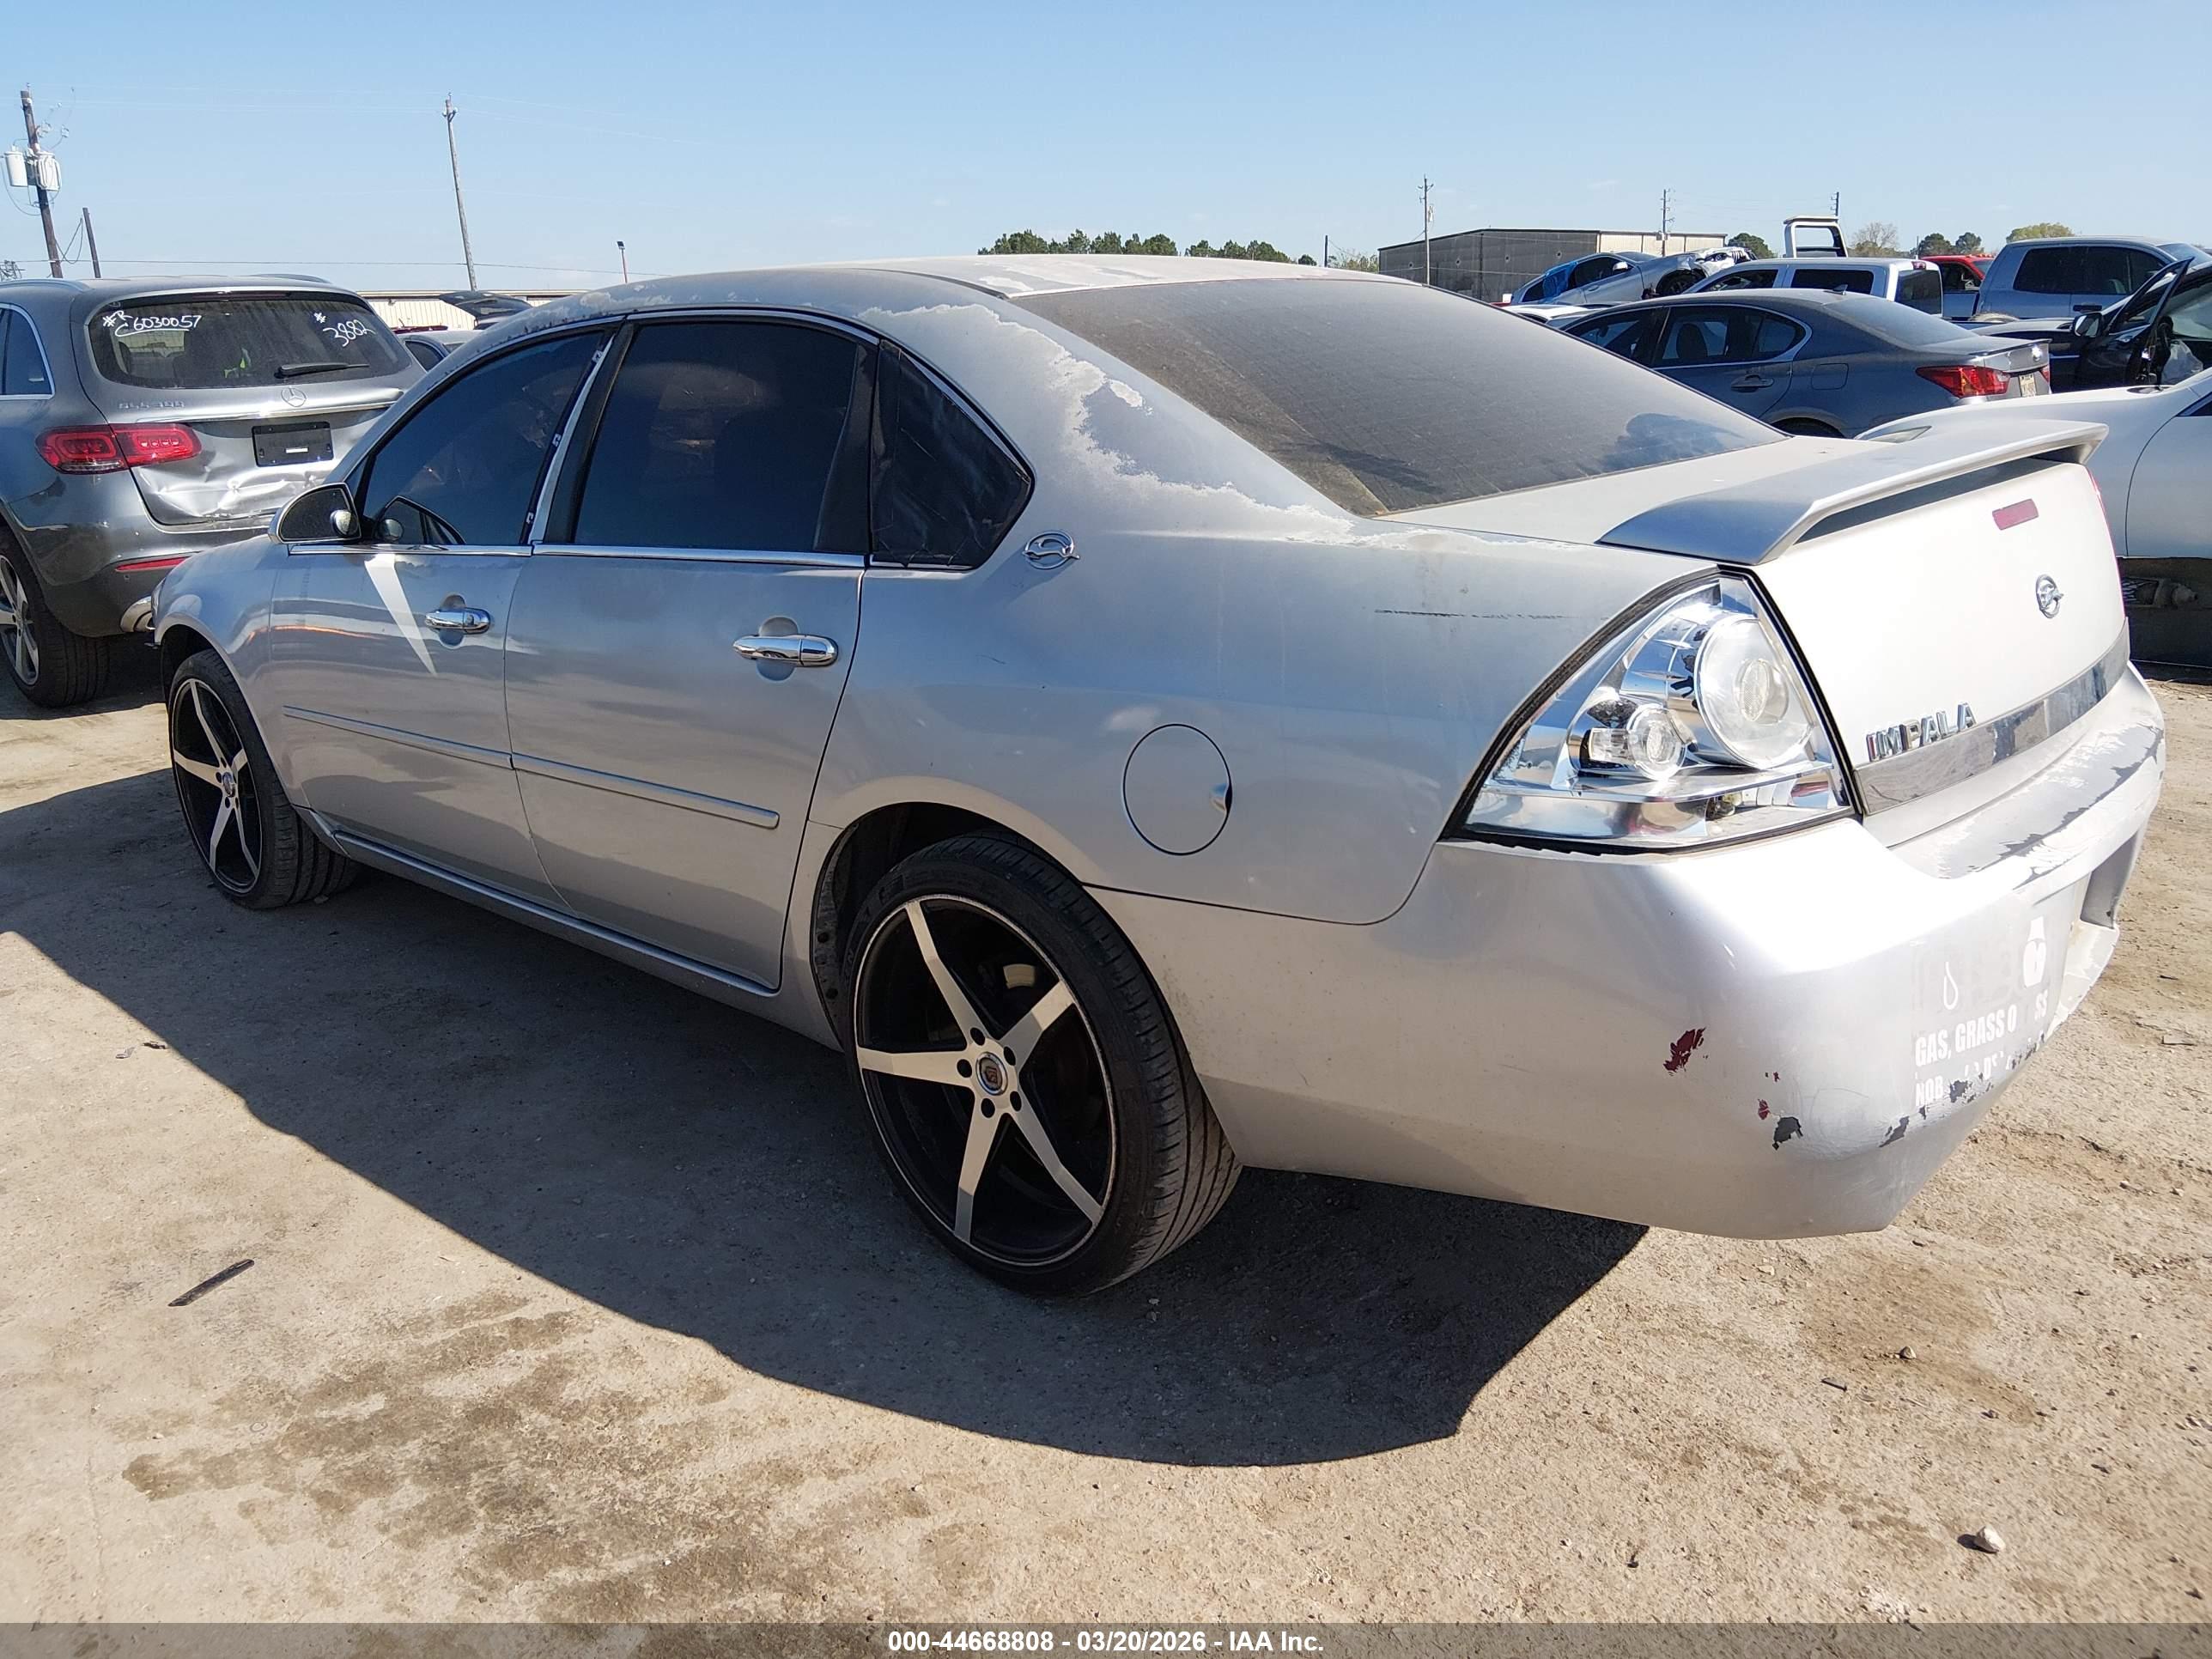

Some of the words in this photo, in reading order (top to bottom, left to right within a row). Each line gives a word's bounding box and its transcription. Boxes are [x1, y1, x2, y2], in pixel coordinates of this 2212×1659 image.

[1866, 702, 1977, 763] IMPALA
[1915, 1030, 1951, 1066] GAS,
[1954, 1009, 2005, 1053] GRASS
